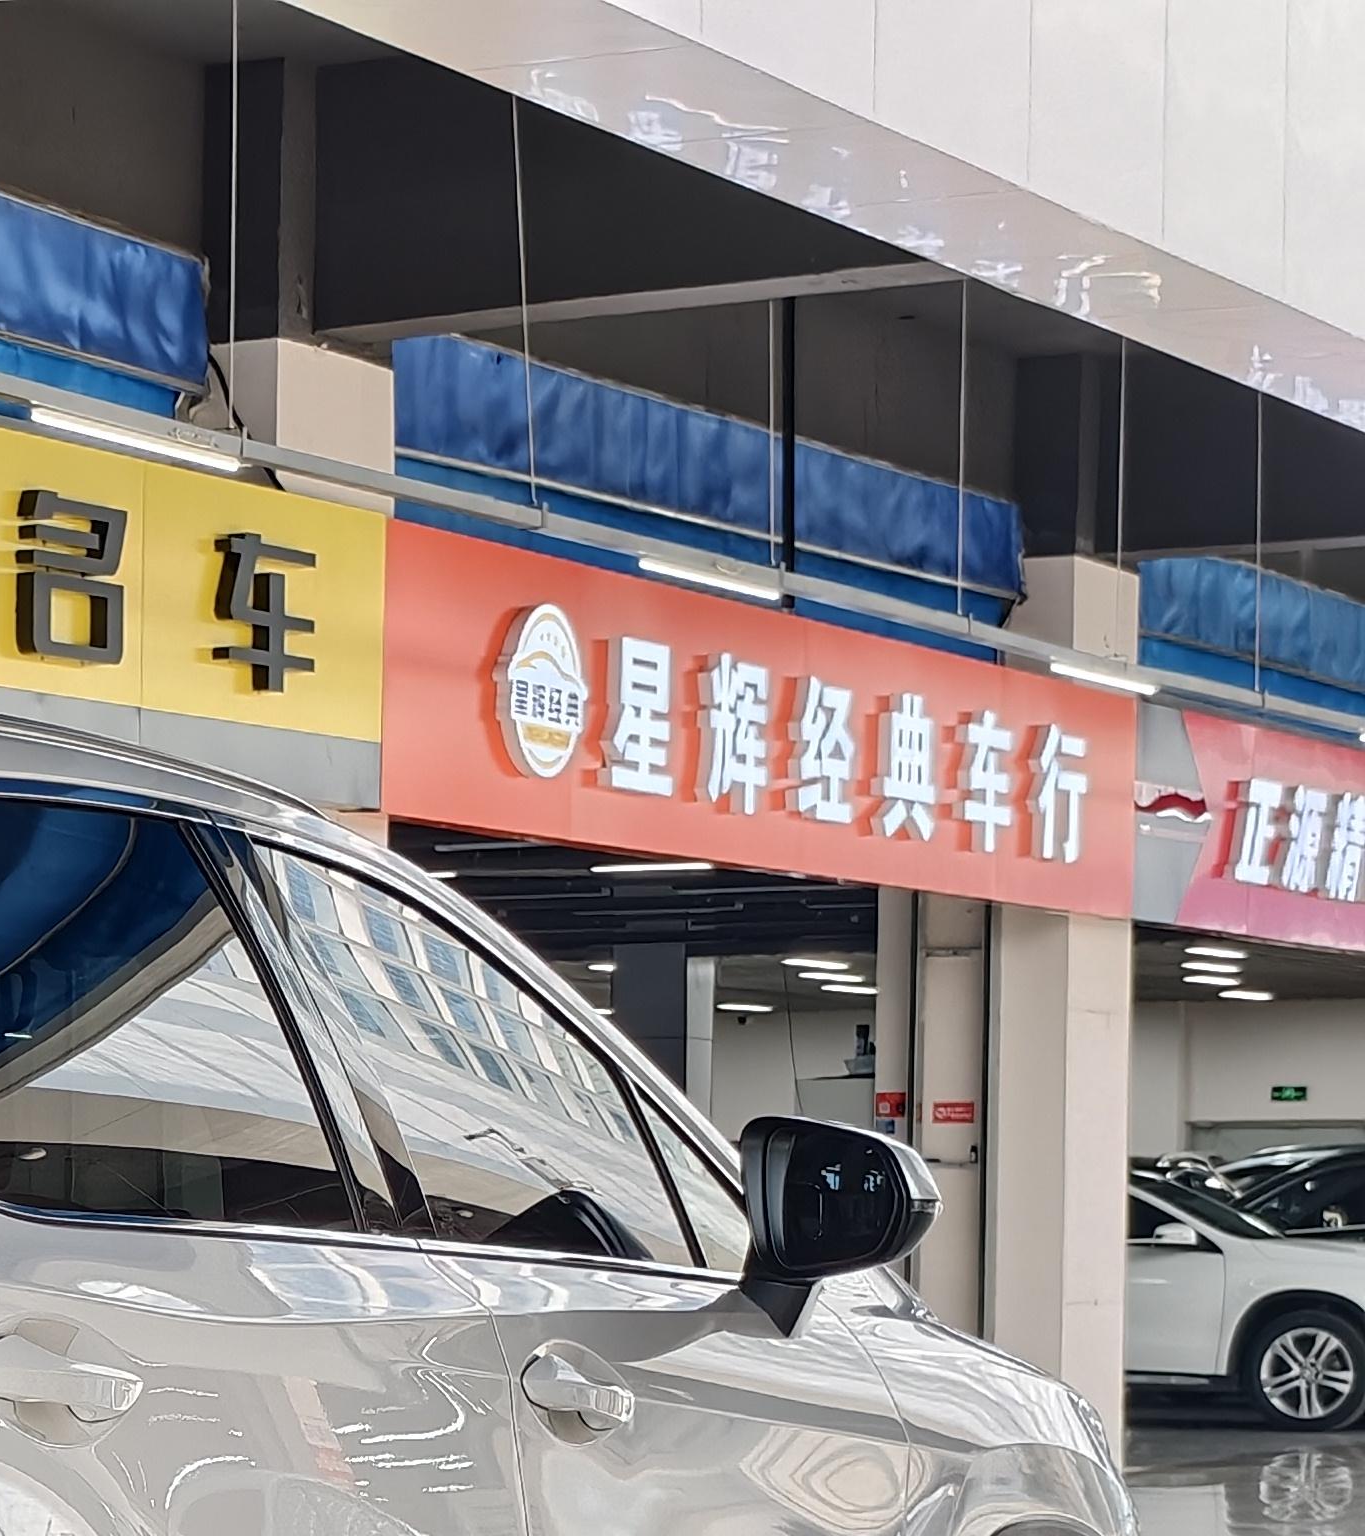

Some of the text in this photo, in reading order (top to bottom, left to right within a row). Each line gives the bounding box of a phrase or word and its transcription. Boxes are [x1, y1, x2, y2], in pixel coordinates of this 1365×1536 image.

[599, 636, 1088, 864] 星辉经典车行
